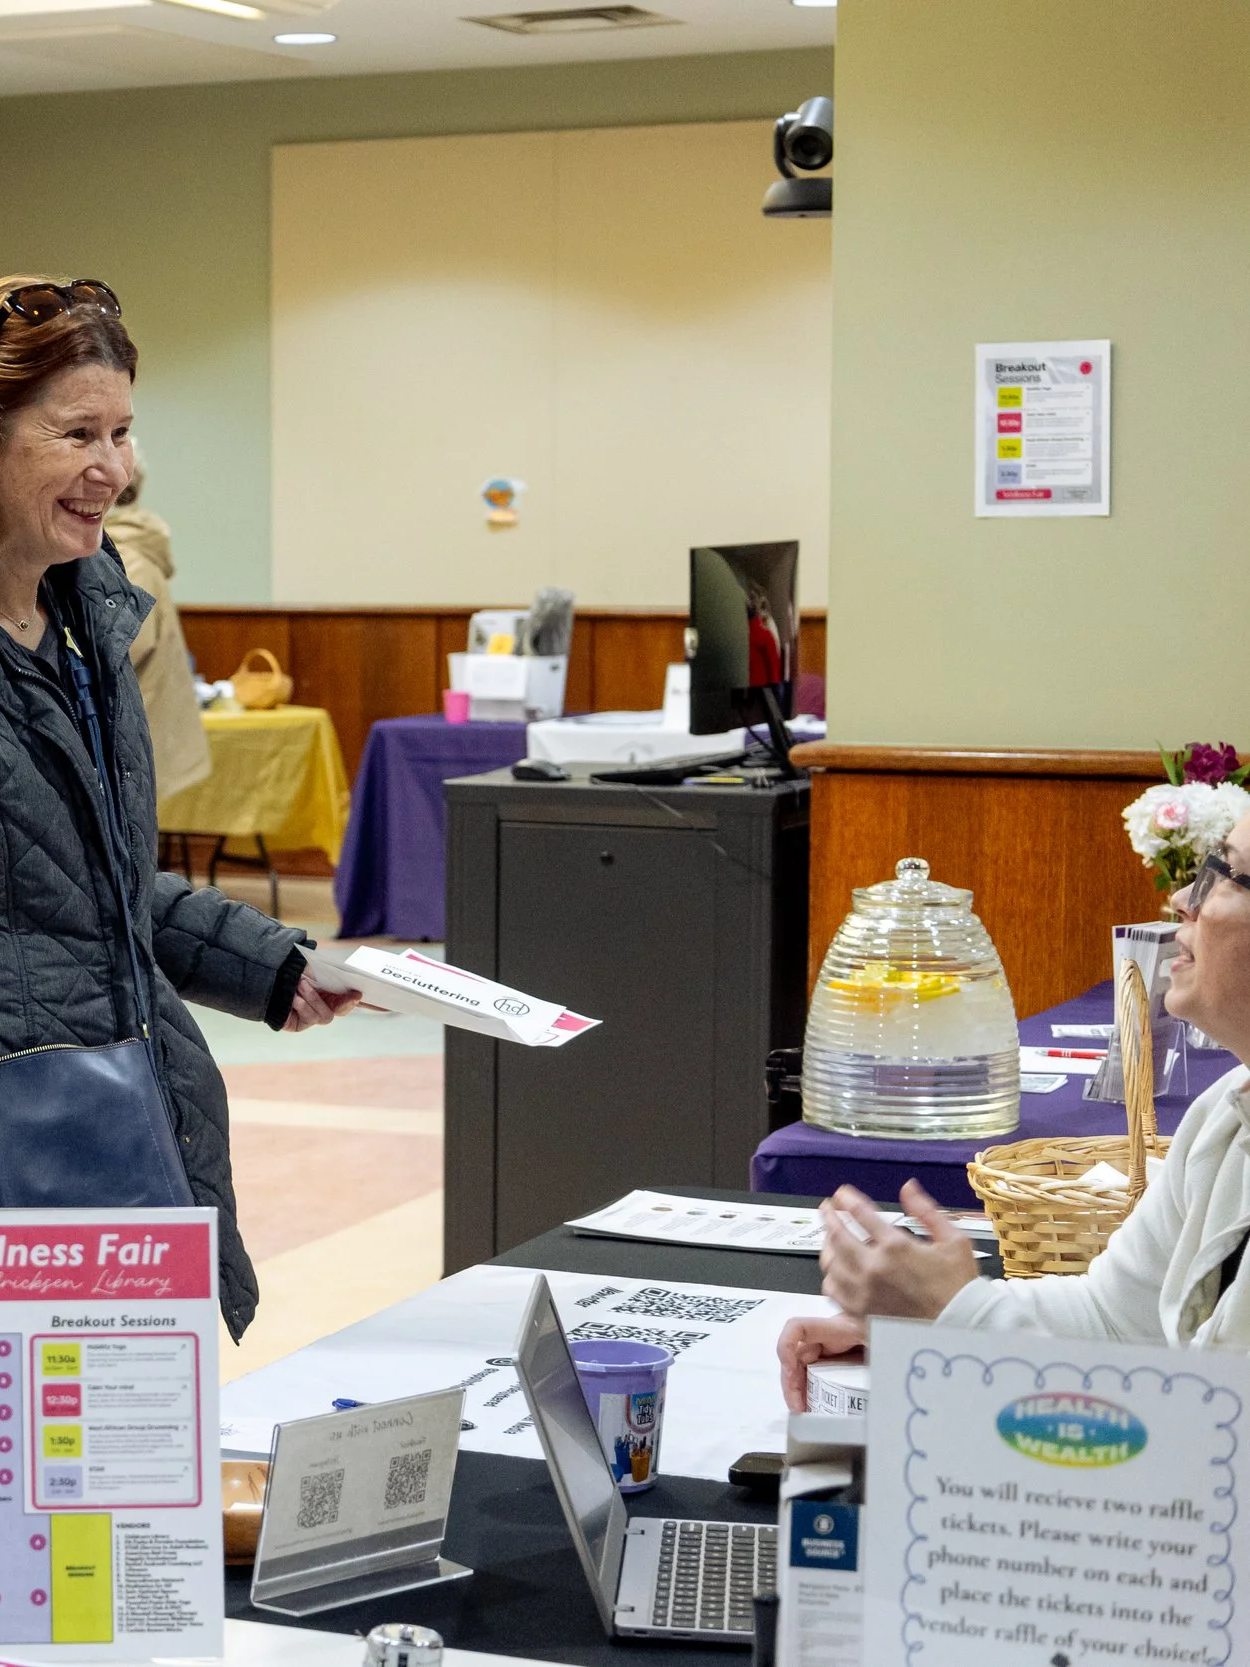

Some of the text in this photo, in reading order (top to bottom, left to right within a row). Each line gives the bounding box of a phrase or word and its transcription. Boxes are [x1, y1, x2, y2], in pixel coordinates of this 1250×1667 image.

[995, 362, 1046, 373] Breakout
[995, 373, 1042, 384] Sessions
[379, 966, 481, 1008] Decluttering
[97, 1233, 170, 1266] Fair
[91, 1269, 174, 1296] Library
[51, 1314, 177, 1328] Breakout Sessions
[46, 1355, 76, 1364] 11:30a
[638, 1405, 653, 1415] Tidy
[847, 1395, 869, 1412] KET
[1014, 1396, 1130, 1430] HEALTH
[636, 1413, 653, 1425] Tubs
[1058, 1422, 1085, 1440] IS
[1014, 1432, 1130, 1462] WEALTH
[49, 1477, 77, 1487] 2:30p
[937, 1475, 1205, 1522] You will recieve two raffle
[941, 1511, 1198, 1560] tickets. Please write your
[927, 1543, 1209, 1593] phone number on each and
[940, 1580, 1193, 1627] place the tickets into the
[919, 1616, 1209, 1666] vendor raffle of your choice!
